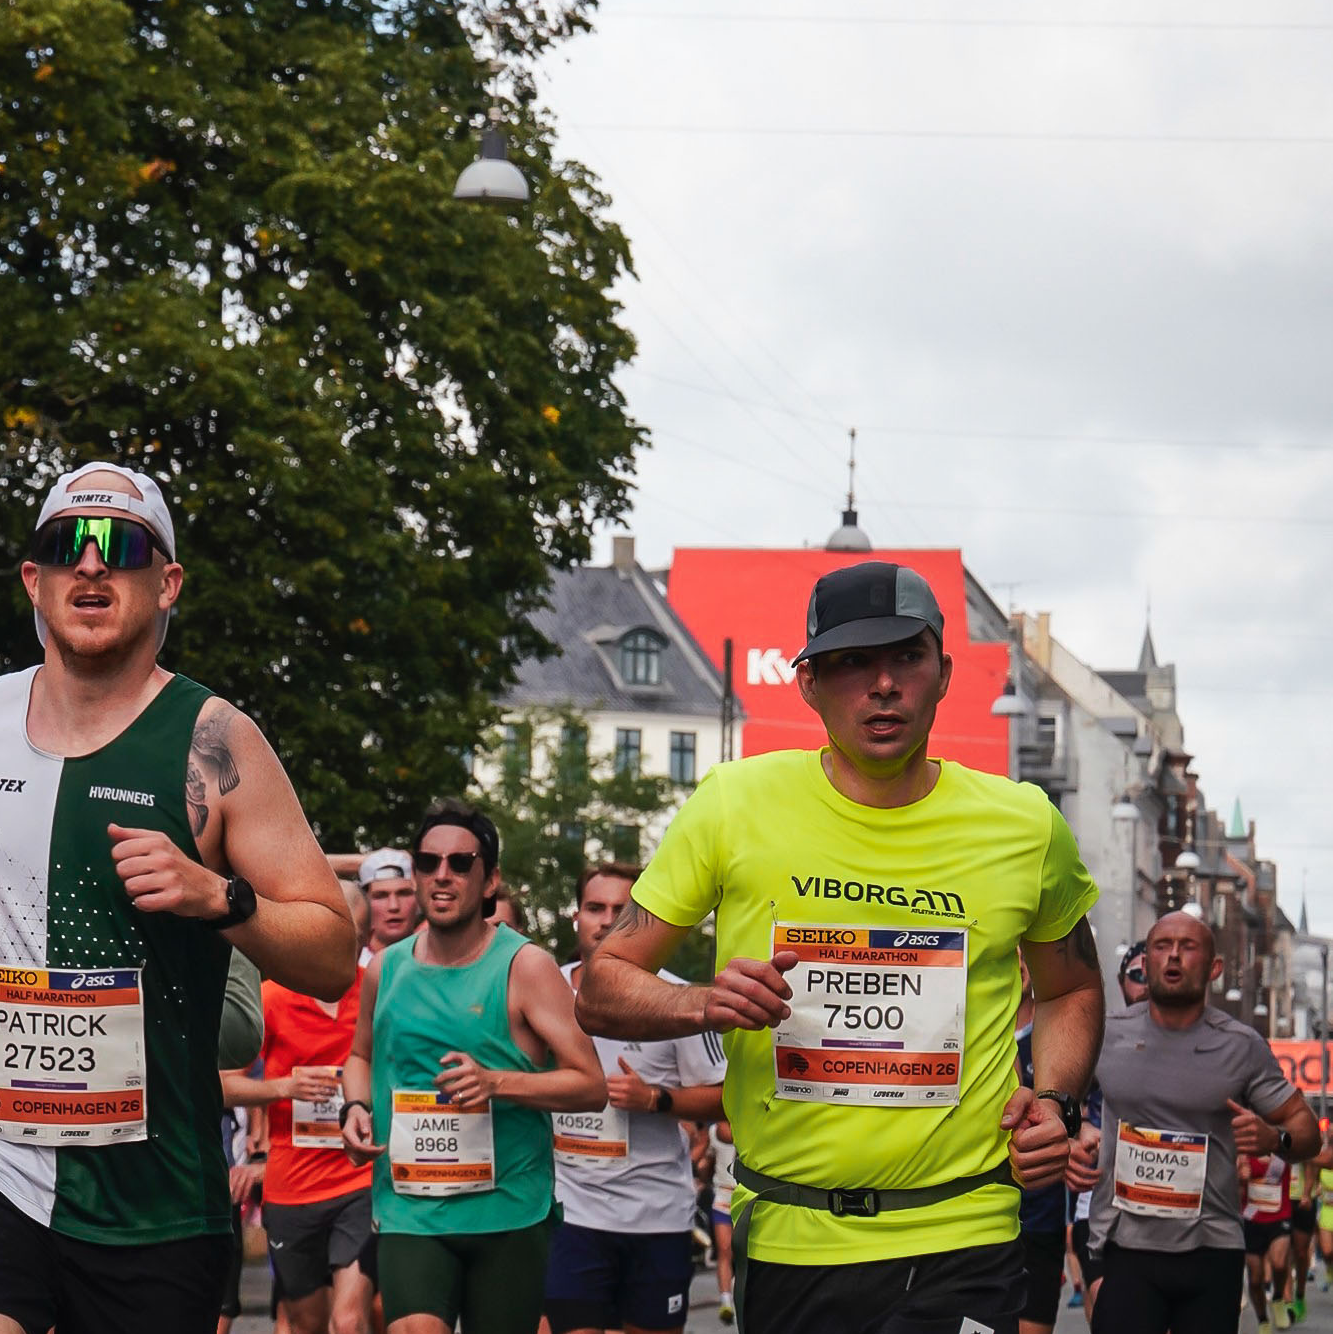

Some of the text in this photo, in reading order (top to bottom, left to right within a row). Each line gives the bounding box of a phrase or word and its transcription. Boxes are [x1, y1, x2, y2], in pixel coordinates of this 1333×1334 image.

[71, 494, 113, 504] TRIMTEX
[88, 785, 156, 807] HVRUNNERS
[786, 929, 856, 945] SEIKO
[909, 935, 940, 946] asics
[819, 948, 918, 962] HALF MARATHON
[85, 974, 115, 987] asics
[807, 969, 922, 996] PREBEN
[6, 990, 96, 1004] HALF MARATHON
[823, 1004, 905, 1030] 7500
[4, 1043, 97, 1073] 27523
[822, 1060, 956, 1077] COPENHAGEN 26
[783, 1085, 812, 1094] zalando
[12, 1100, 141, 1115] COPENHAGEN 26
[413, 1118, 460, 1132] JAMIE
[557, 1114, 604, 1131] 40522
[415, 1137, 458, 1152] 8968
[1128, 1146, 1190, 1167] THOMAS
[1135, 1165, 1176, 1182] 6247
